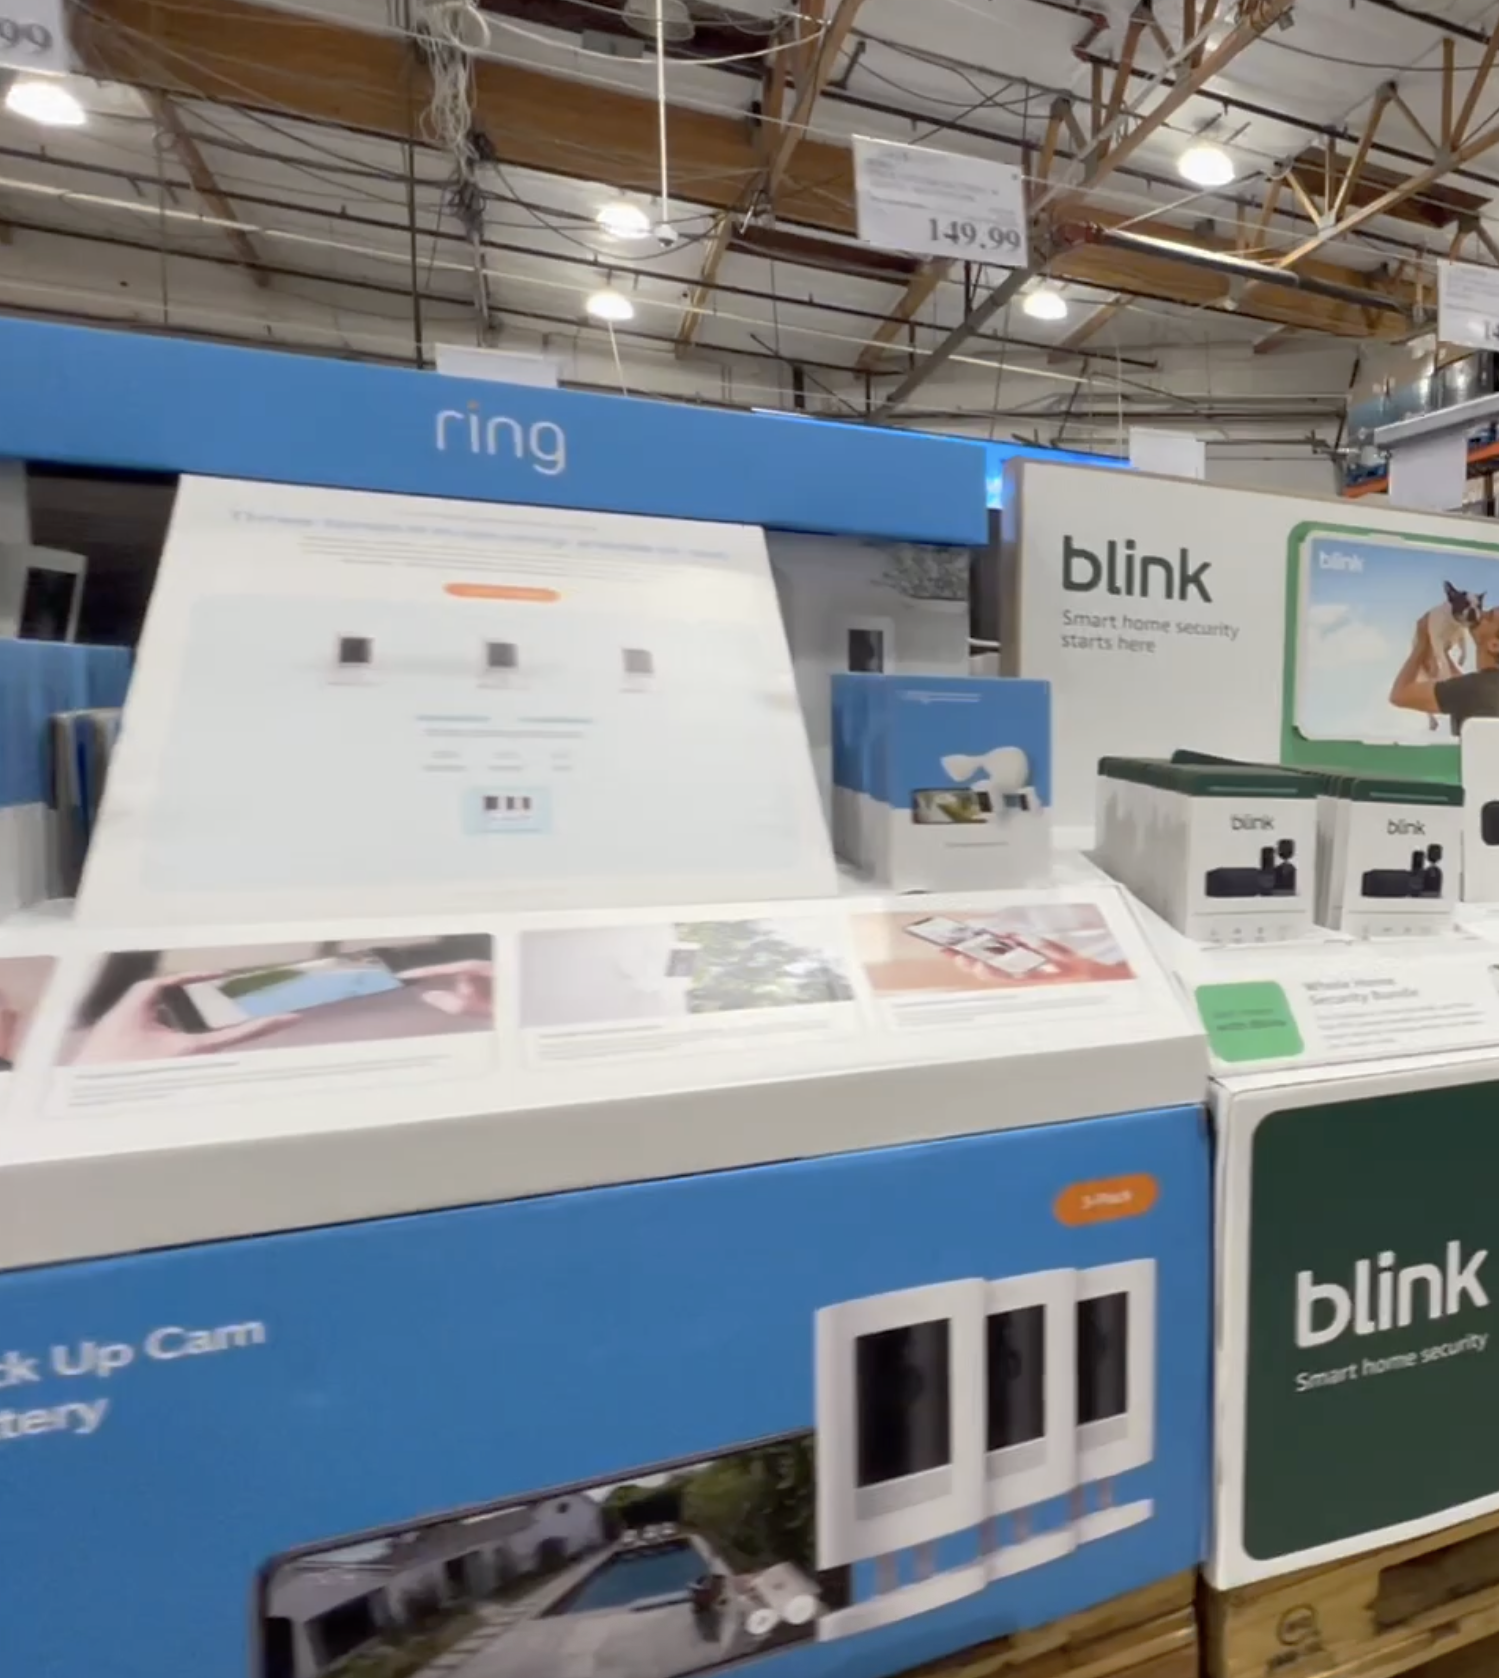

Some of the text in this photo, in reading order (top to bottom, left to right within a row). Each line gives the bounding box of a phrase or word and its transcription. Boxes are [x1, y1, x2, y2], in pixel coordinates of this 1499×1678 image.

[929, 218, 1021, 250] 149.99
[436, 399, 566, 476] ring
[1062, 534, 1213, 604] blink
[1319, 550, 1364, 573] blink
[1062, 609, 1240, 642] Smart home security
[1061, 633, 1156, 653] starts here
[1230, 813, 1275, 831] blink
[1387, 819, 1427, 836] blink
[1296, 1239, 1491, 1349] blink
[51, 1340, 134, 1378] Up
[144, 1321, 266, 1360] Cam
[1296, 1333, 1489, 1392] Smart home security
